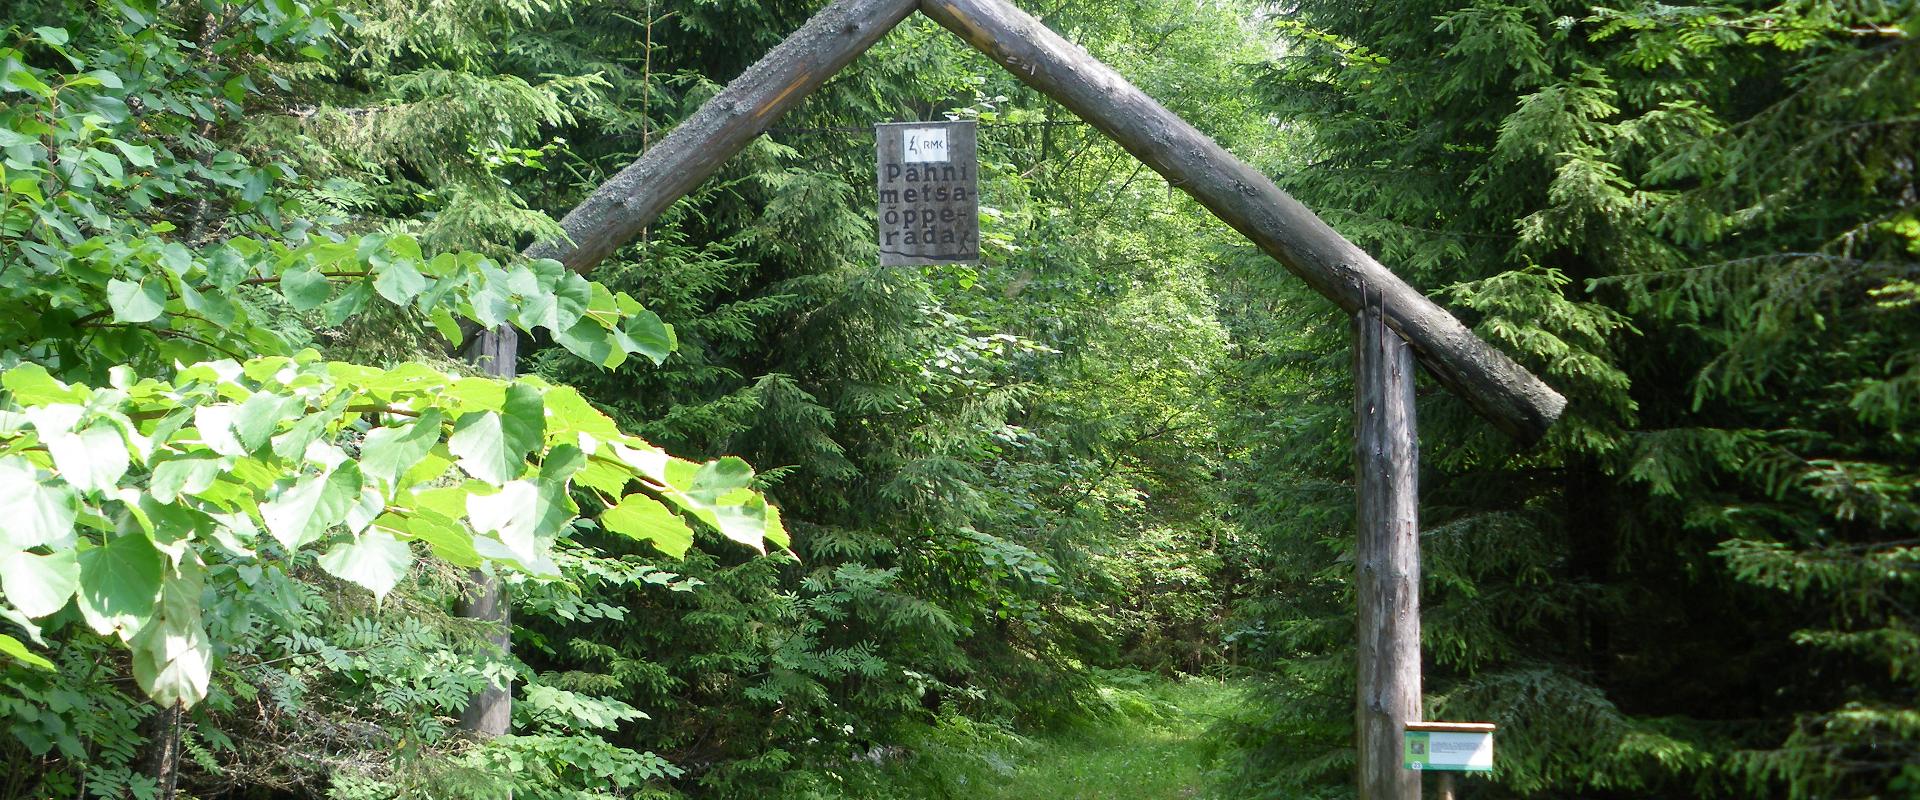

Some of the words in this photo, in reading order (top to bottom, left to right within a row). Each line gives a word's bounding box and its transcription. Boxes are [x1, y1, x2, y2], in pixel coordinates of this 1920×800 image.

[923, 140, 944, 150] RMK
[886, 162, 968, 183] Pähni
[880, 184, 976, 203] metsa-
[884, 206, 967, 229] õppe-
[885, 225, 956, 246] rada
